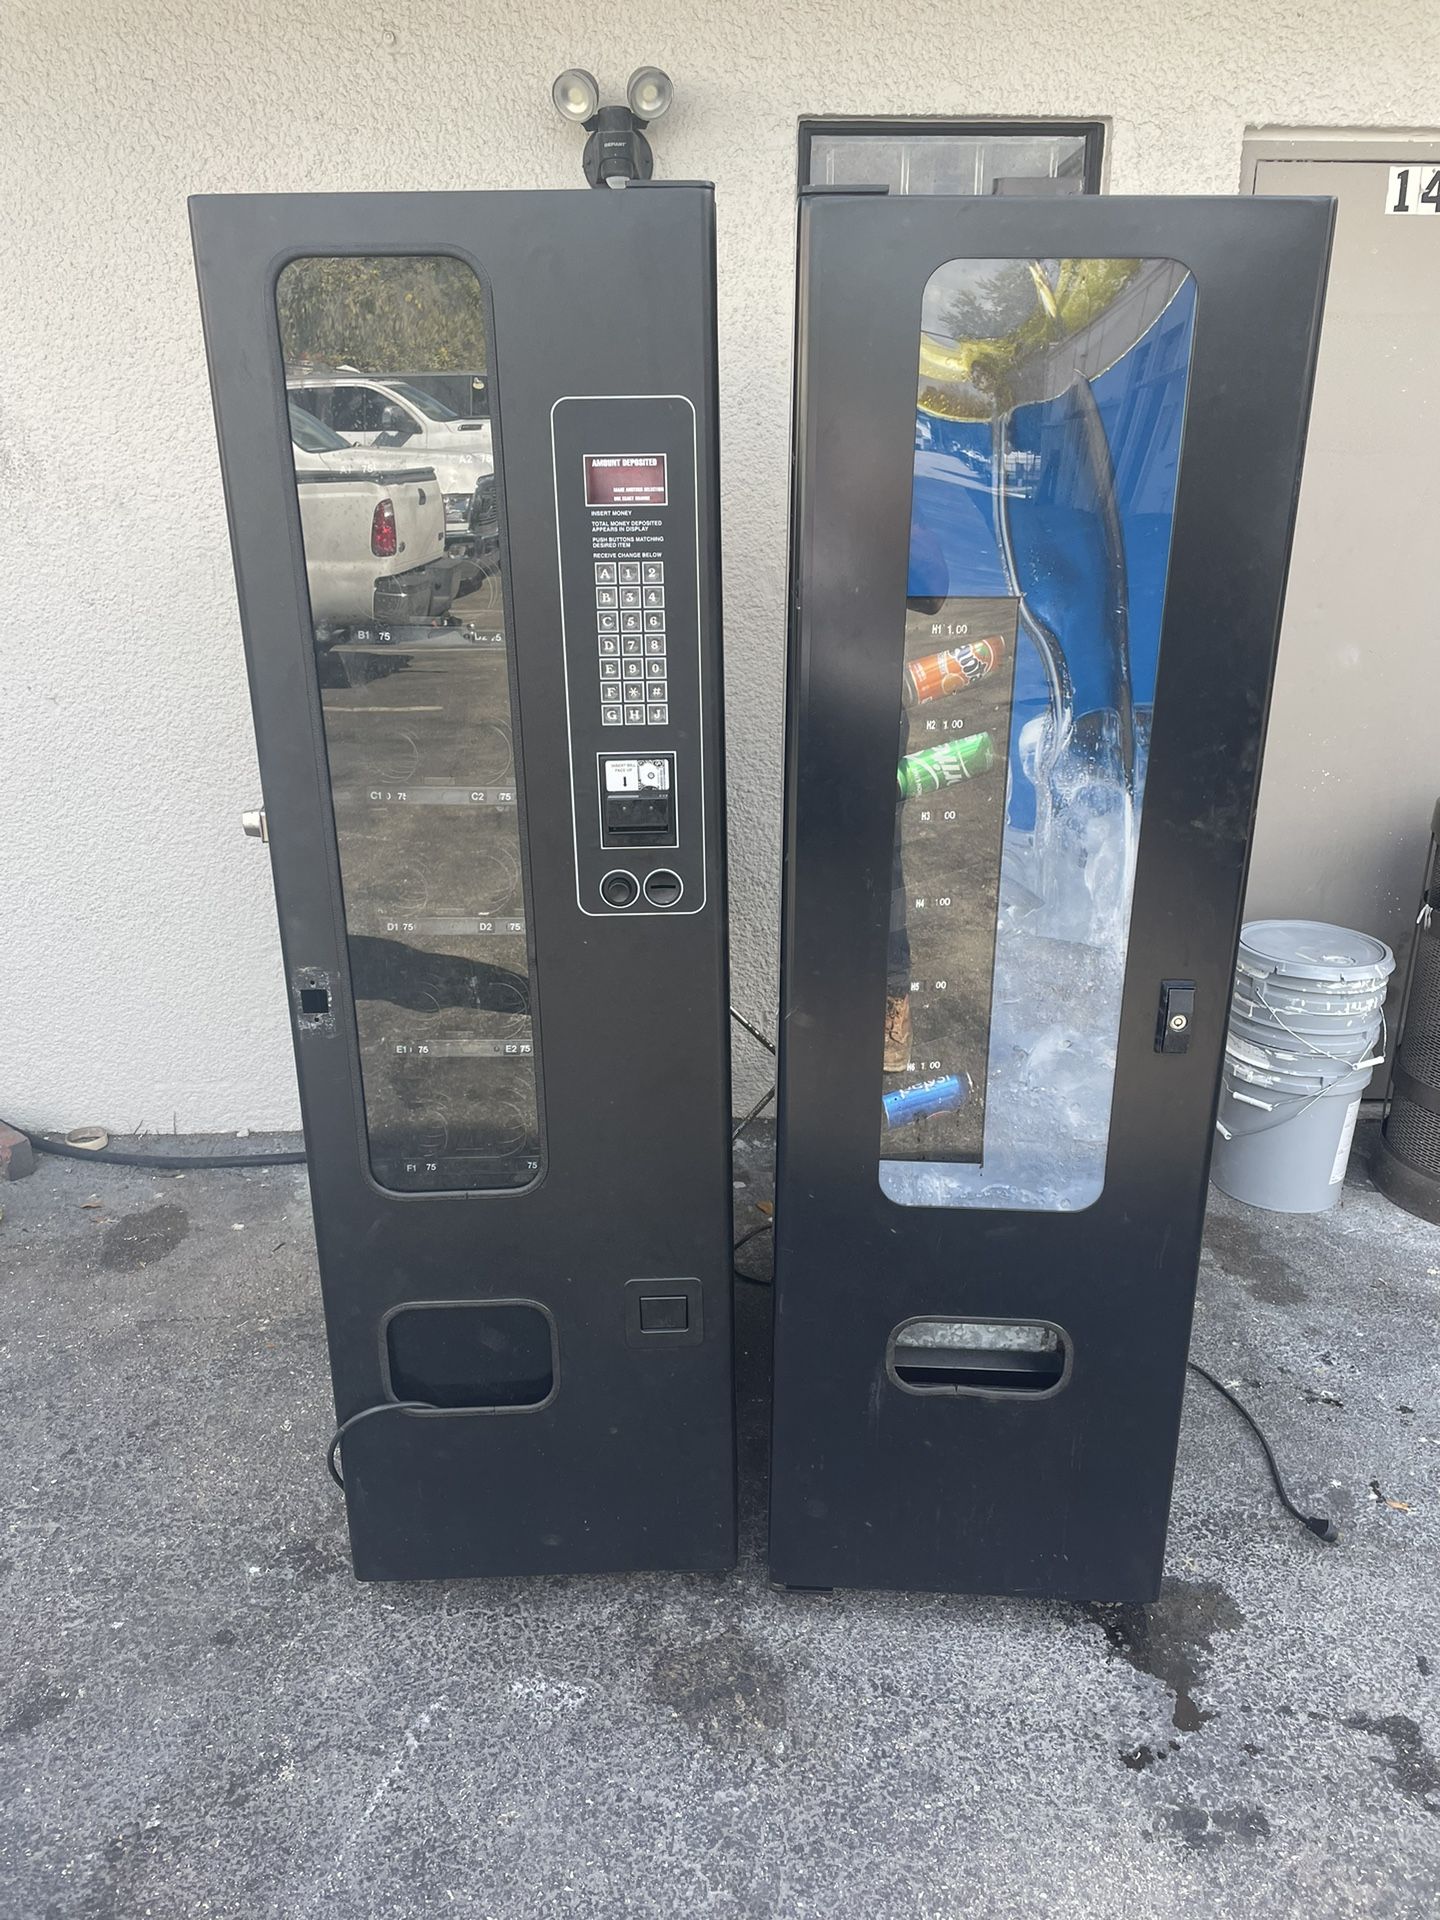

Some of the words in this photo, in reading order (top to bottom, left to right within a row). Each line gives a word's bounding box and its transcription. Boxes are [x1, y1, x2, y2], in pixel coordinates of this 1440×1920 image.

[1393, 169, 1440, 212] 14
[592, 458, 620, 467] AMOUNT
[622, 458, 657, 466] DEPOSITED
[600, 569, 610, 579] A
[625, 569, 632, 578] 1
[648, 568, 656, 578] 2
[602, 593, 611, 603] B
[626, 593, 634, 602] 3
[649, 593, 656, 602] 4
[602, 617, 612, 626] C
[627, 617, 635, 626] 5
[650, 617, 657, 626] 6
[932, 624, 941, 634] H1
[947, 624, 968, 634] 1.00
[358, 630, 369, 639] B1
[379, 632, 390, 640] 75
[604, 641, 614, 650] D
[628, 641, 635, 650] 7
[651, 640, 658, 649] 8
[606, 664, 615, 674] E
[629, 664, 636, 673] 9
[652, 664, 659, 673] 0
[607, 687, 616, 697] F
[607, 711, 617, 720] G
[629, 710, 640, 720] H
[654, 710, 661, 719] J
[926, 720, 936, 730] H2
[370, 792, 381, 800] C1
[471, 792, 484, 800] C2
